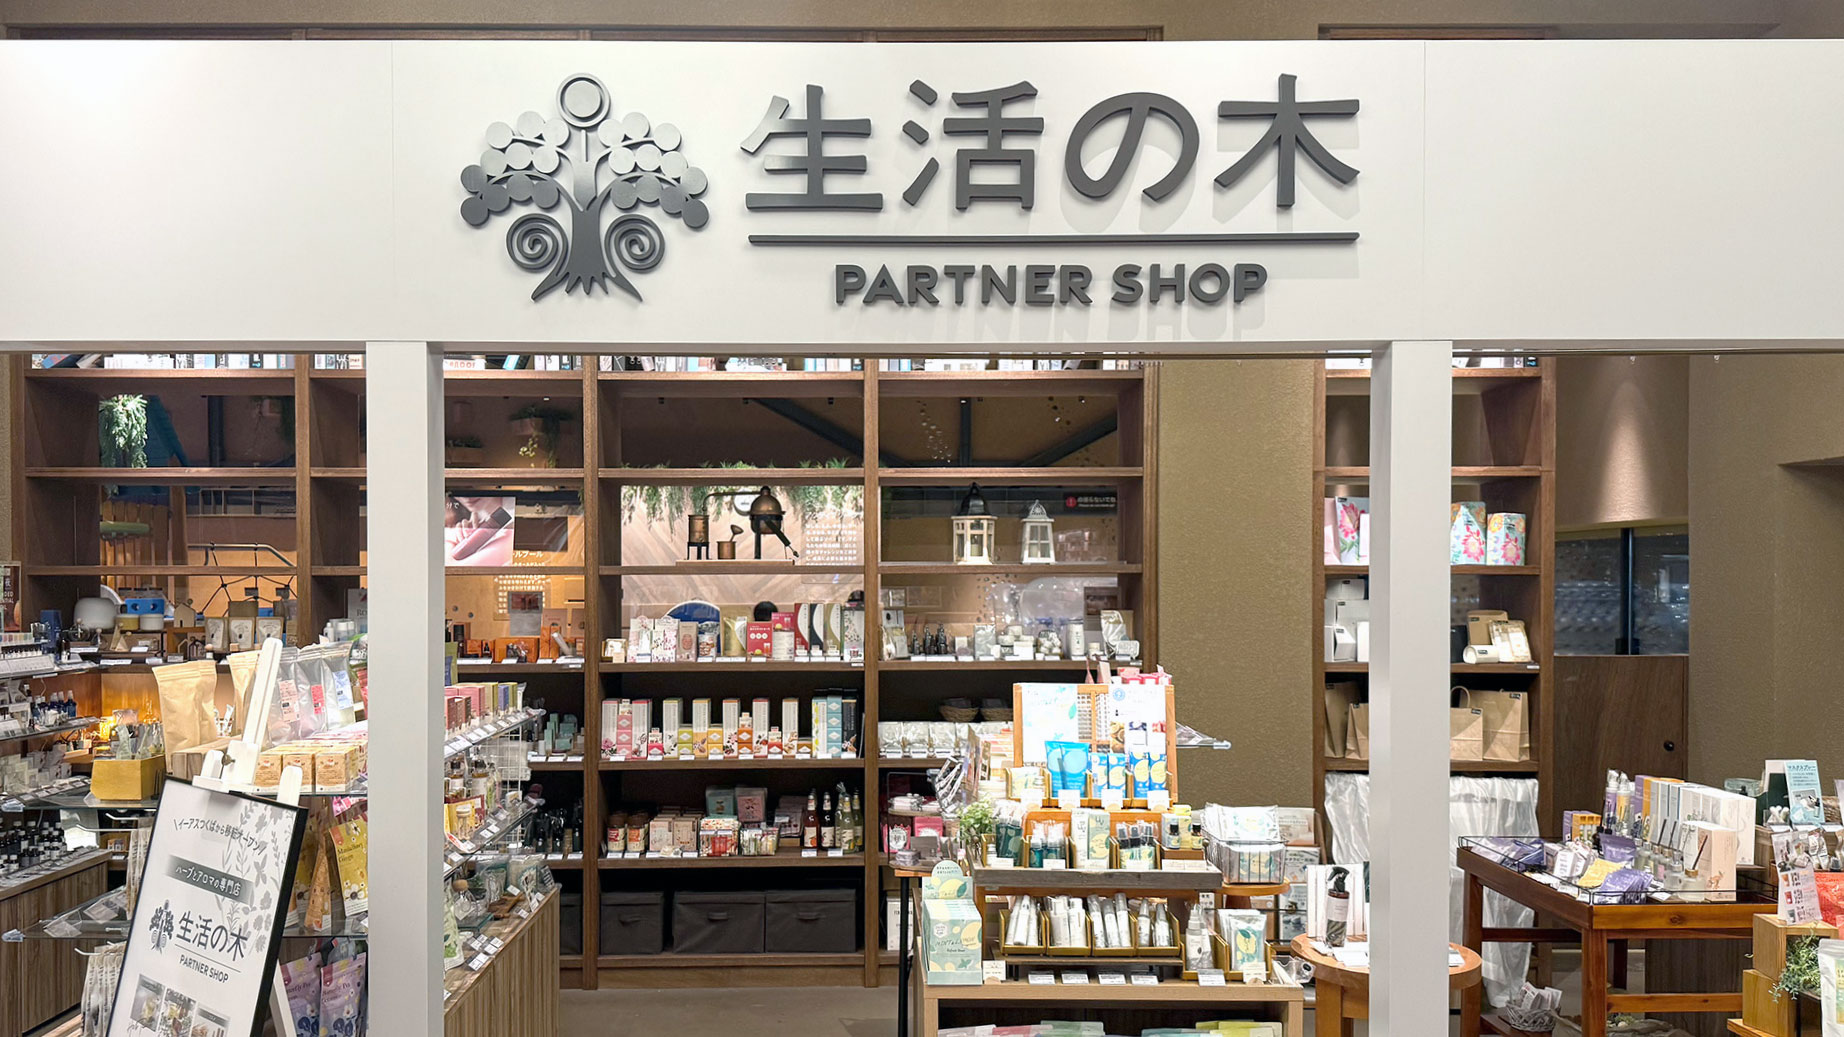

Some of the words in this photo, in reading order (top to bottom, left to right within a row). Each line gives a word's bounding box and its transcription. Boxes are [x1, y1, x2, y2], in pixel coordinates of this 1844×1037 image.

[741, 74, 1360, 211] 生活の木
[835, 264, 1092, 305] PARTNER
[1112, 263, 1268, 306] SHOP
[175, 866, 242, 896] ハーブとアロマの専門店
[176, 911, 249, 962] 生活の木
[179, 954, 208, 977] PARTNER
[209, 968, 229, 984] SHOP
